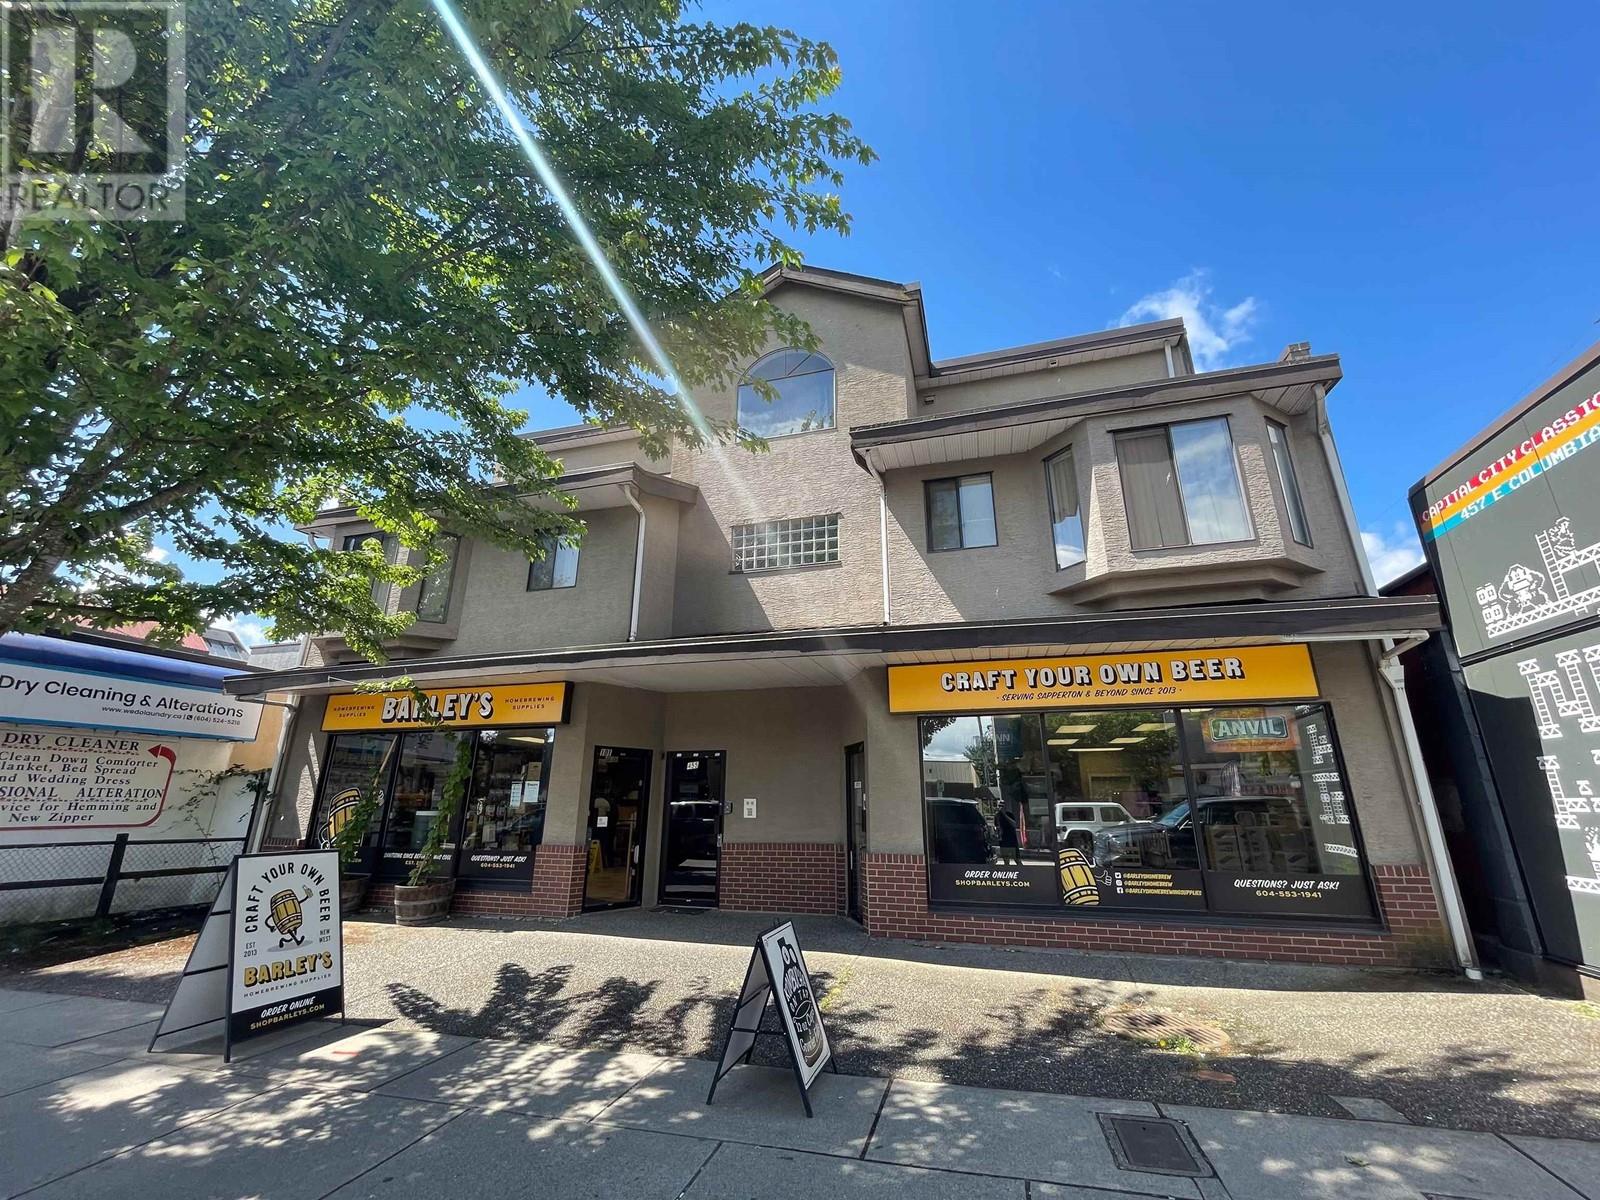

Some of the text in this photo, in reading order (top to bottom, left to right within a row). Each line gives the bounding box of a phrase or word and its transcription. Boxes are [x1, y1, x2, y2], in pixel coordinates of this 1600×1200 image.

[1460, 424, 1600, 520] 457 E COLUMBIA
[1422, 479, 1479, 522] CAPITAL
[1478, 450, 1518, 484] CITY
[941, 657, 1246, 692] CRAFT YOUR OWN BEER
[0, 675, 244, 718] Dry Cleaning & Alterations
[1001, 686, 1177, 701] SERVING SAPPERTON & BEYOND SINCE 2013
[1218, 719, 1282, 737] ANVIL
[4, 732, 140, 751] DRY CLEANER
[0, 751, 159, 768] Clean Down Comforter
[62, 764, 88, 773] Bed
[94, 765, 137, 776] Spread
[28, 774, 87, 785] Wedding
[95, 775, 132, 785] Dress
[76, 787, 165, 799] ALTERATION
[39, 802, 60, 812] for
[67, 802, 130, 812] Hemming
[135, 802, 158, 811] and
[8, 812, 94, 824] New Zipper
[955, 879, 1030, 887] SHOPBARLEYS.COM
[964, 870, 1020, 879] ORDER ONLINE
[1233, 879, 1340, 890] QUESTIONS? JUST ASK!
[244, 862, 331, 933] CRAFT YOUR OWN BEER
[1255, 890, 1322, 898] 604-553-1941
[243, 949, 257, 958] 2013
[244, 951, 333, 987] BARLEY'S
[243, 973, 332, 998] HOMEBREWING SUPPLIES
[261, 996, 316, 1018] ORDER ONLINE
[250, 1003, 325, 1030] SHOPBARLEYS.COM
